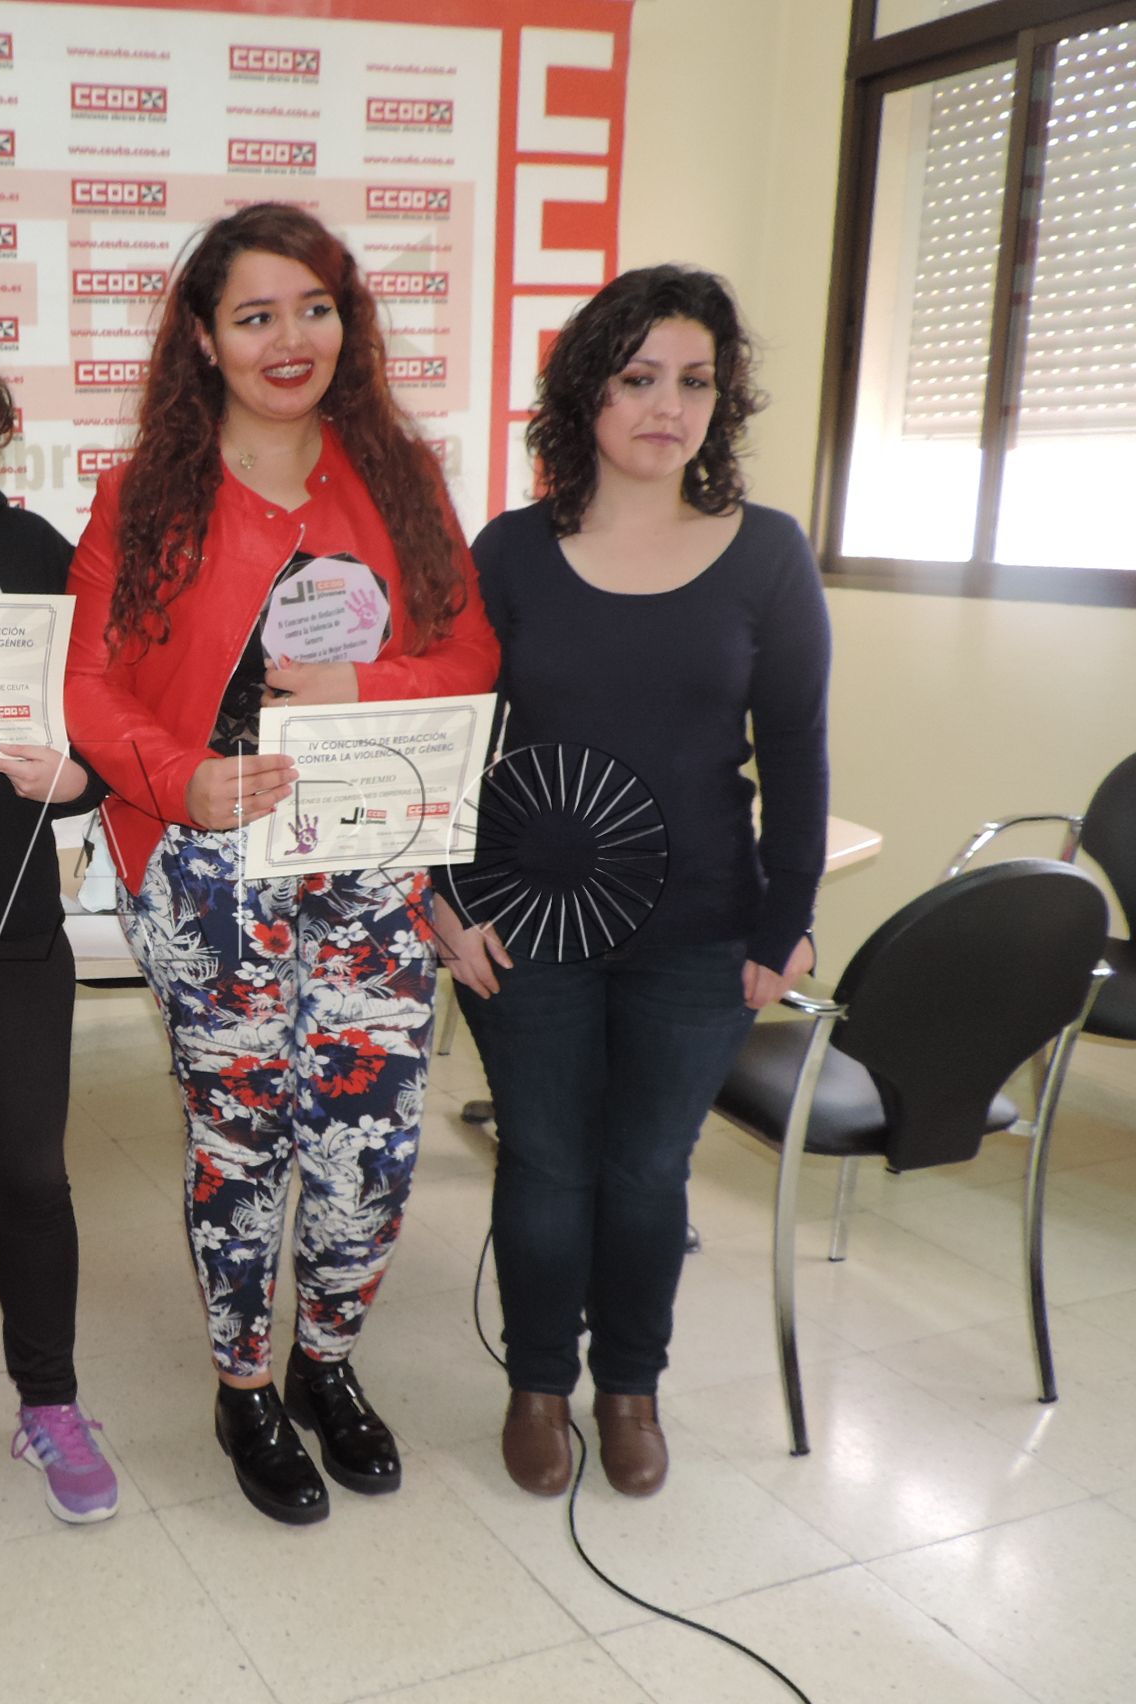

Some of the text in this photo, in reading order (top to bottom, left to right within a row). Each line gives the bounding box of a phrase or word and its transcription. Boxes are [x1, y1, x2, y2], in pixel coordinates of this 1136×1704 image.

[233, 49, 292, 70] CCOO
[75, 87, 138, 110] CCOO
[370, 102, 428, 122] CCOO
[232, 142, 290, 163] CCOO
[75, 183, 138, 202] CCOO
[369, 189, 426, 208] CCOO
[76, 273, 139, 293] CCOO
[369, 275, 424, 293] CCOO
[386, 360, 422, 377] COO
[309, 742, 319, 751] IV
[321, 738, 377, 750] CONCURSO
[379, 737, 390, 746] DE
[297, 753, 337, 764] CONTRA
[340, 753, 351, 762] LA
[354, 748, 402, 760] VIOLENCIA
[404, 747, 417, 756] DE
